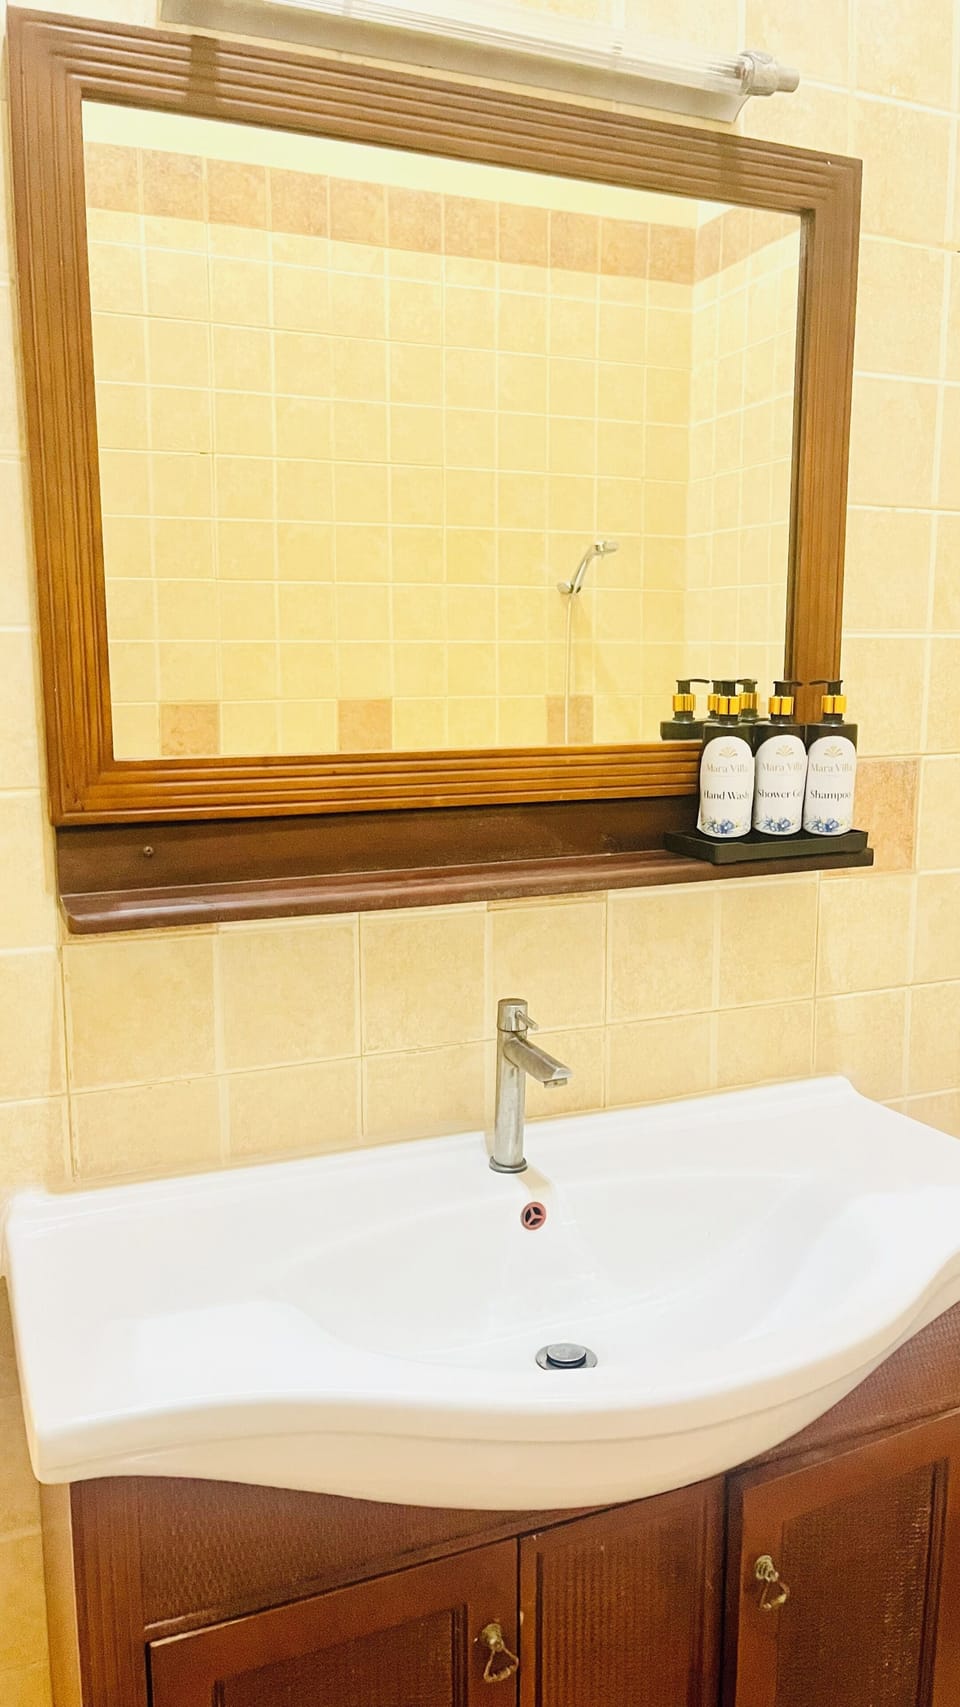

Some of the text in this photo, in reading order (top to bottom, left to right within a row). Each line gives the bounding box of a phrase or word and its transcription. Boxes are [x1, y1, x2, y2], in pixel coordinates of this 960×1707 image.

[706, 763, 728, 773] Mara
[762, 763, 785, 772] Mara
[811, 763, 833, 772] Mara
[704, 790, 749, 800] Hand Wash
[757, 789, 801, 799] Shower Ge
